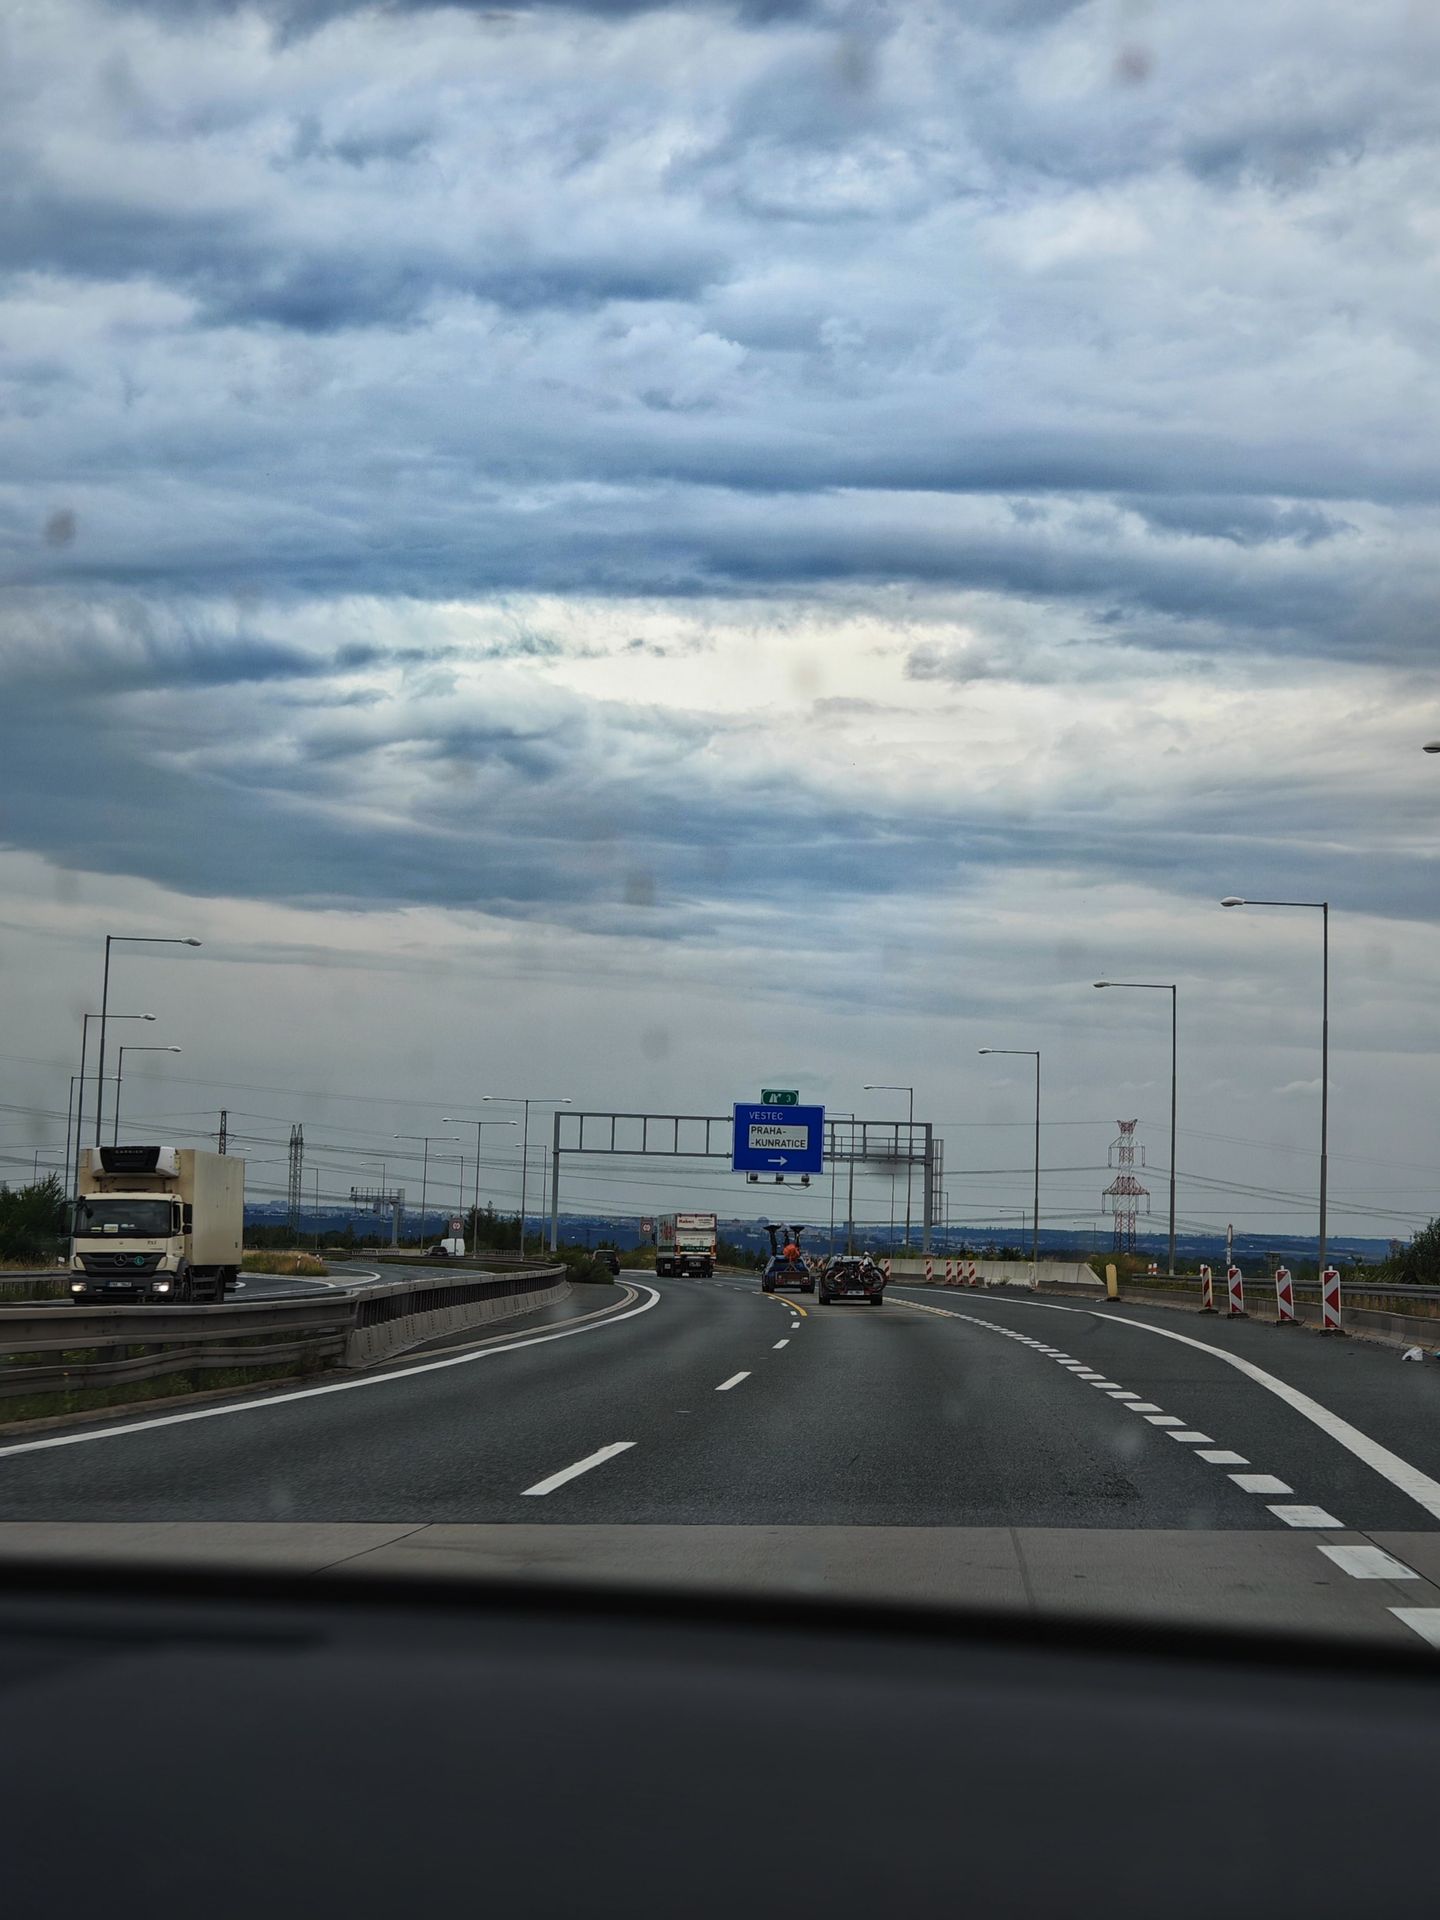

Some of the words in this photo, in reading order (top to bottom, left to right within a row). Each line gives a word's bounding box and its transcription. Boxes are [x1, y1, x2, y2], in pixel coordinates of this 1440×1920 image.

[786, 1094, 791, 1103] 3
[749, 1111, 783, 1120] VESTEC
[751, 1126, 787, 1135] PRAHA-
[751, 1138, 806, 1148] -KUNRATICE
